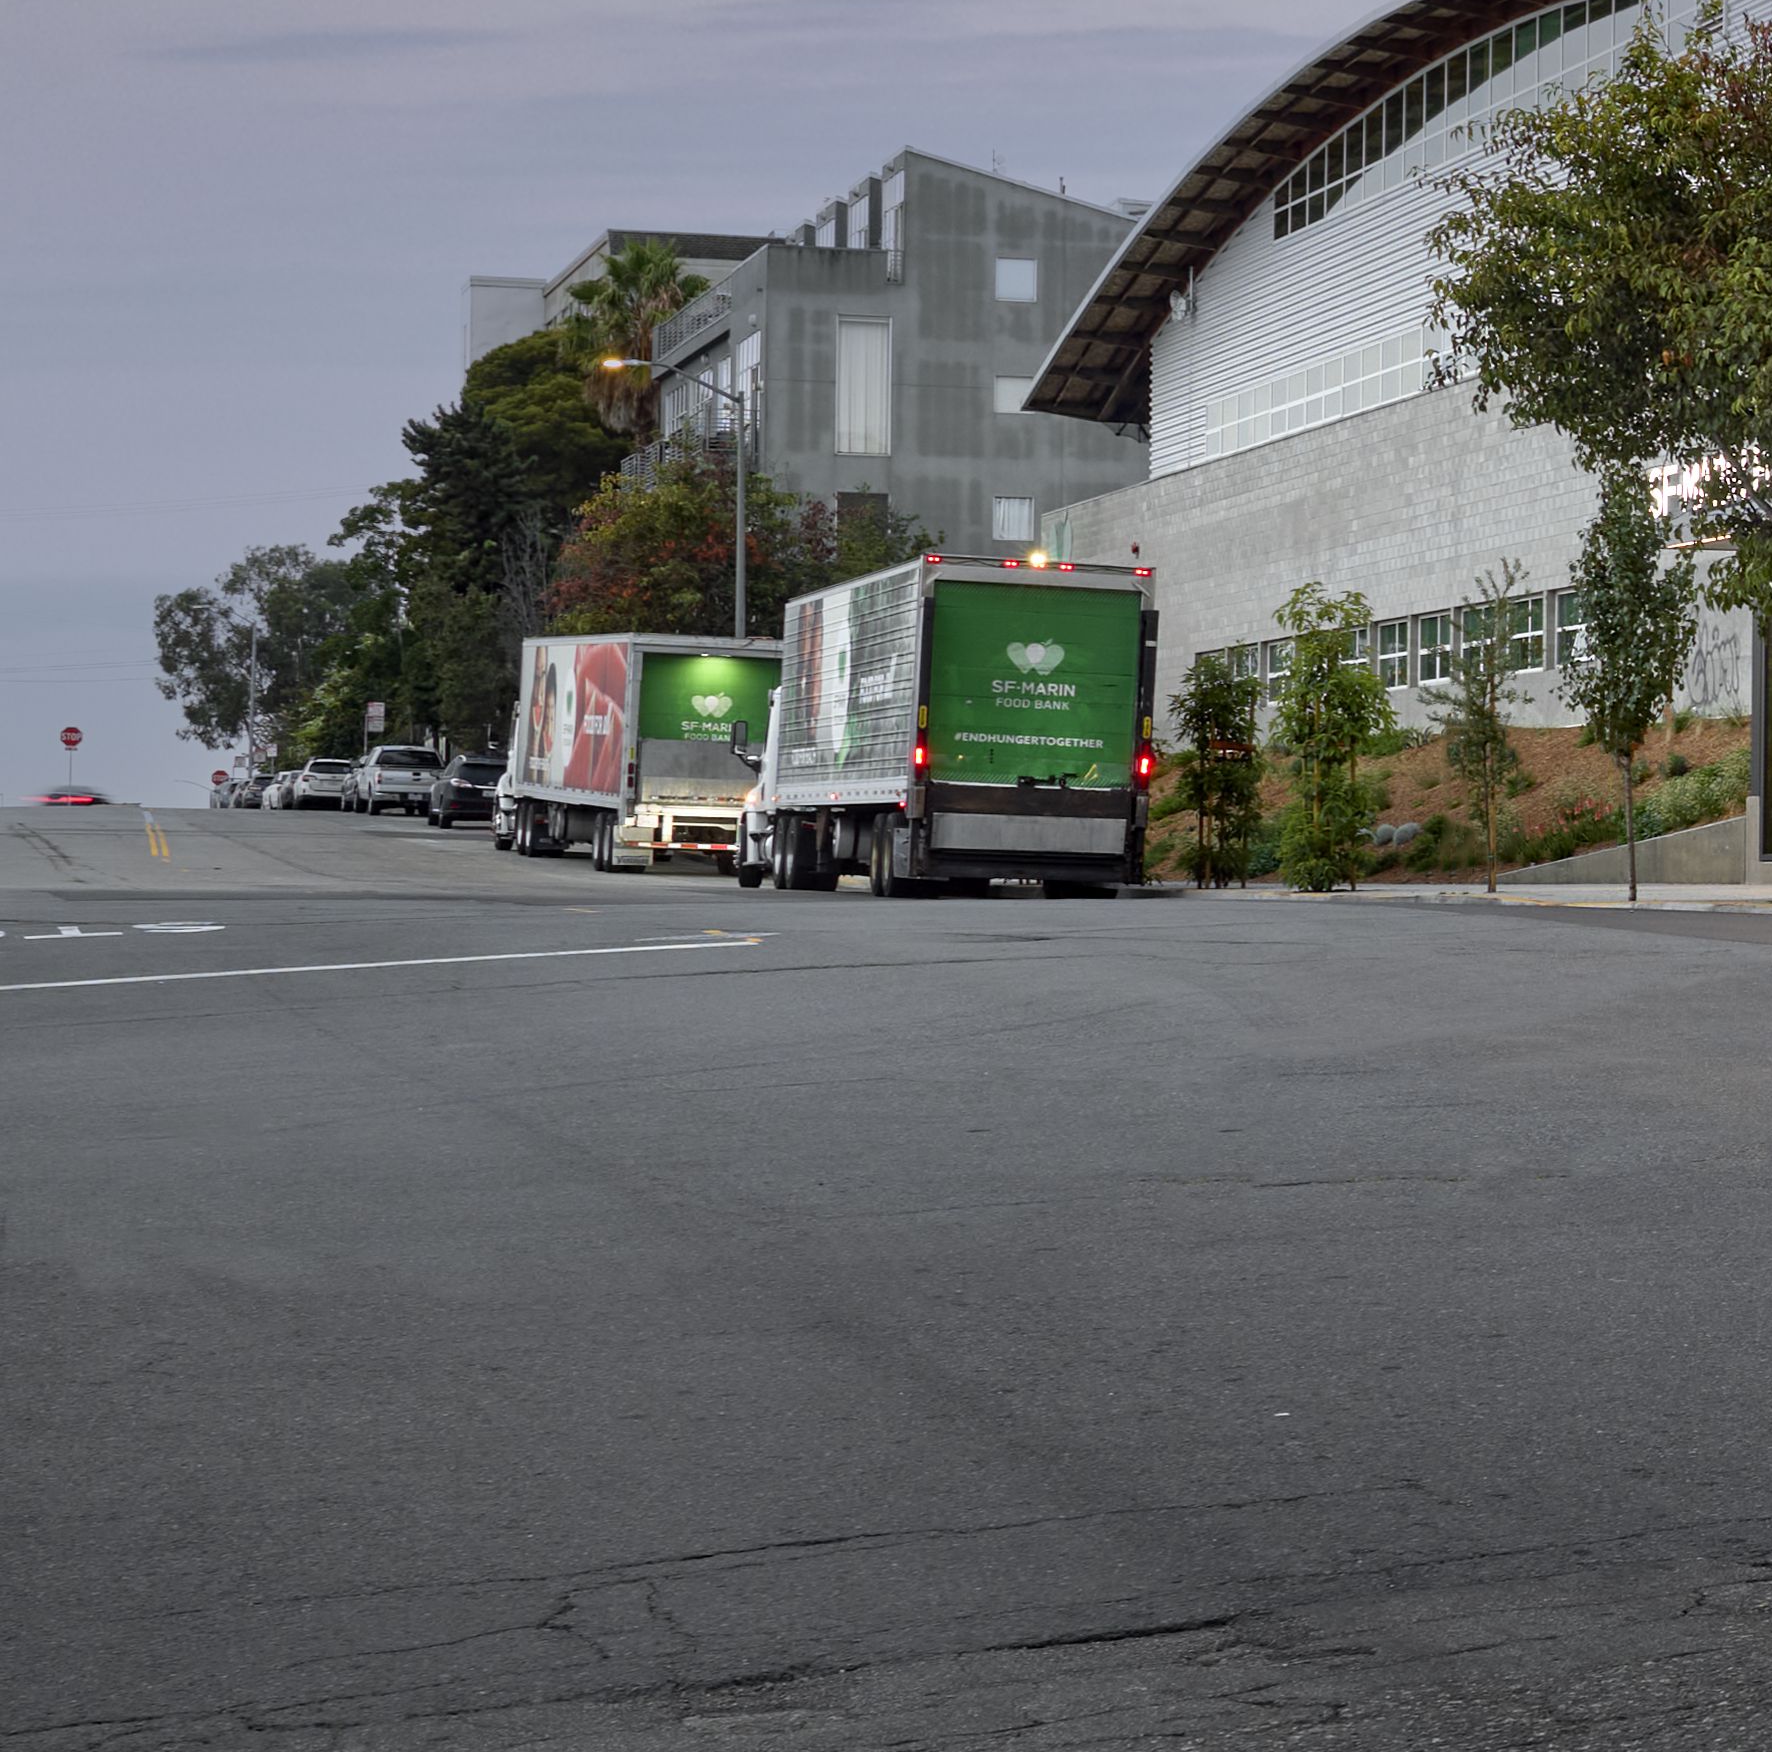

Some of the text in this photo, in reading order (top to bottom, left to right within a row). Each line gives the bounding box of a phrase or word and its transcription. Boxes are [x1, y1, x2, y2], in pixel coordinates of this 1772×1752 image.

[995, 697, 1070, 711] FOOD BANK
[61, 732, 82, 742] STOP
[684, 732, 731, 742] FOOD BAN
[954, 732, 1104, 749] #ENDHUNGERTOGETHER
